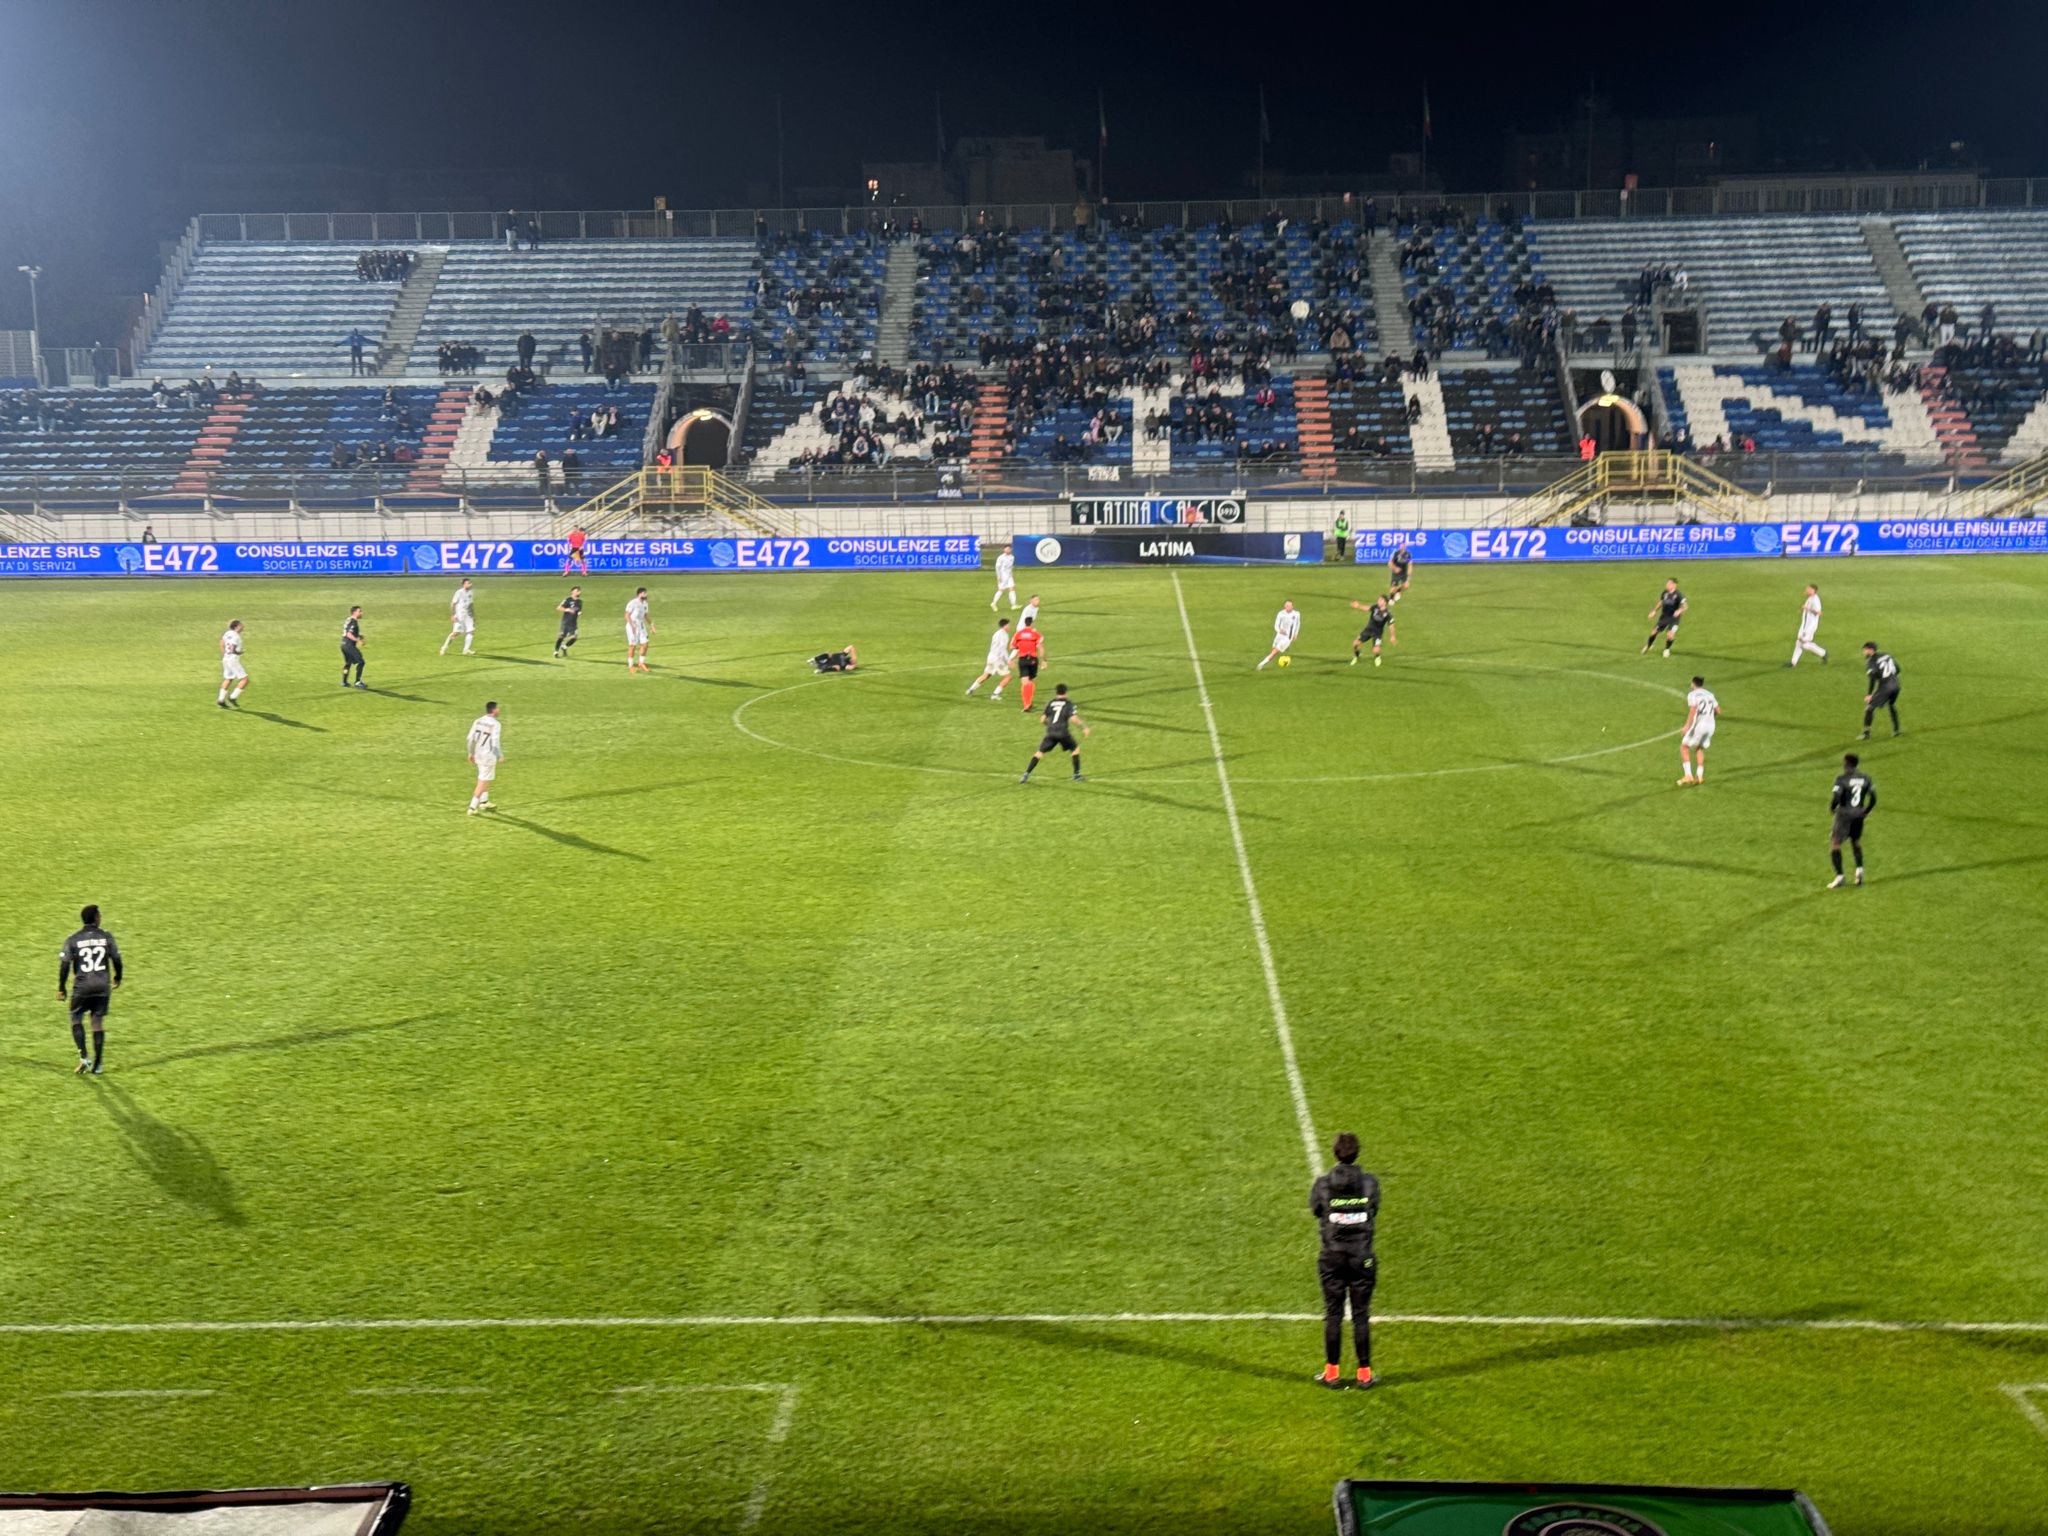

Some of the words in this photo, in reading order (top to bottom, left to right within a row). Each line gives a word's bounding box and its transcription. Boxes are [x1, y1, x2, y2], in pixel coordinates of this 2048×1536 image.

[1093, 500, 1151, 525] LATINA
[1355, 533, 1377, 547] ZE
[1381, 532, 1427, 547] SRLS
[1565, 527, 1685, 544] CONSULENZE
[1689, 526, 1737, 542] SRLS
[1781, 523, 1860, 553] E472
[235, 544, 350, 558] CONSULENZE
[353, 544, 398, 557] SRLS
[531, 542, 645, 556] CONULENZE
[649, 541, 695, 555] SRLS
[827, 540, 941, 554] CONSULENZE
[1139, 541, 1195, 557] LATINA
[1471, 530, 1547, 558] E472
[1647, 543, 1659, 554] DI
[1663, 542, 1709, 553] SERVIZI
[56, 546, 101, 559] SRLS
[143, 544, 220, 572] E472
[440, 542, 515, 569] E472
[737, 540, 811, 567] E472
[907, 554, 918, 565] DI
[17, 561, 29, 571] DI
[32, 561, 77, 571] SERVIZI
[316, 560, 328, 570] DI
[329, 559, 373, 570] SERVIZI
[610, 557, 623, 568] DI
[625, 556, 669, 568] SERVIZI
[1052, 705, 1064, 724] 7
[475, 729, 491, 747] 77
[78, 946, 107, 973] 32
